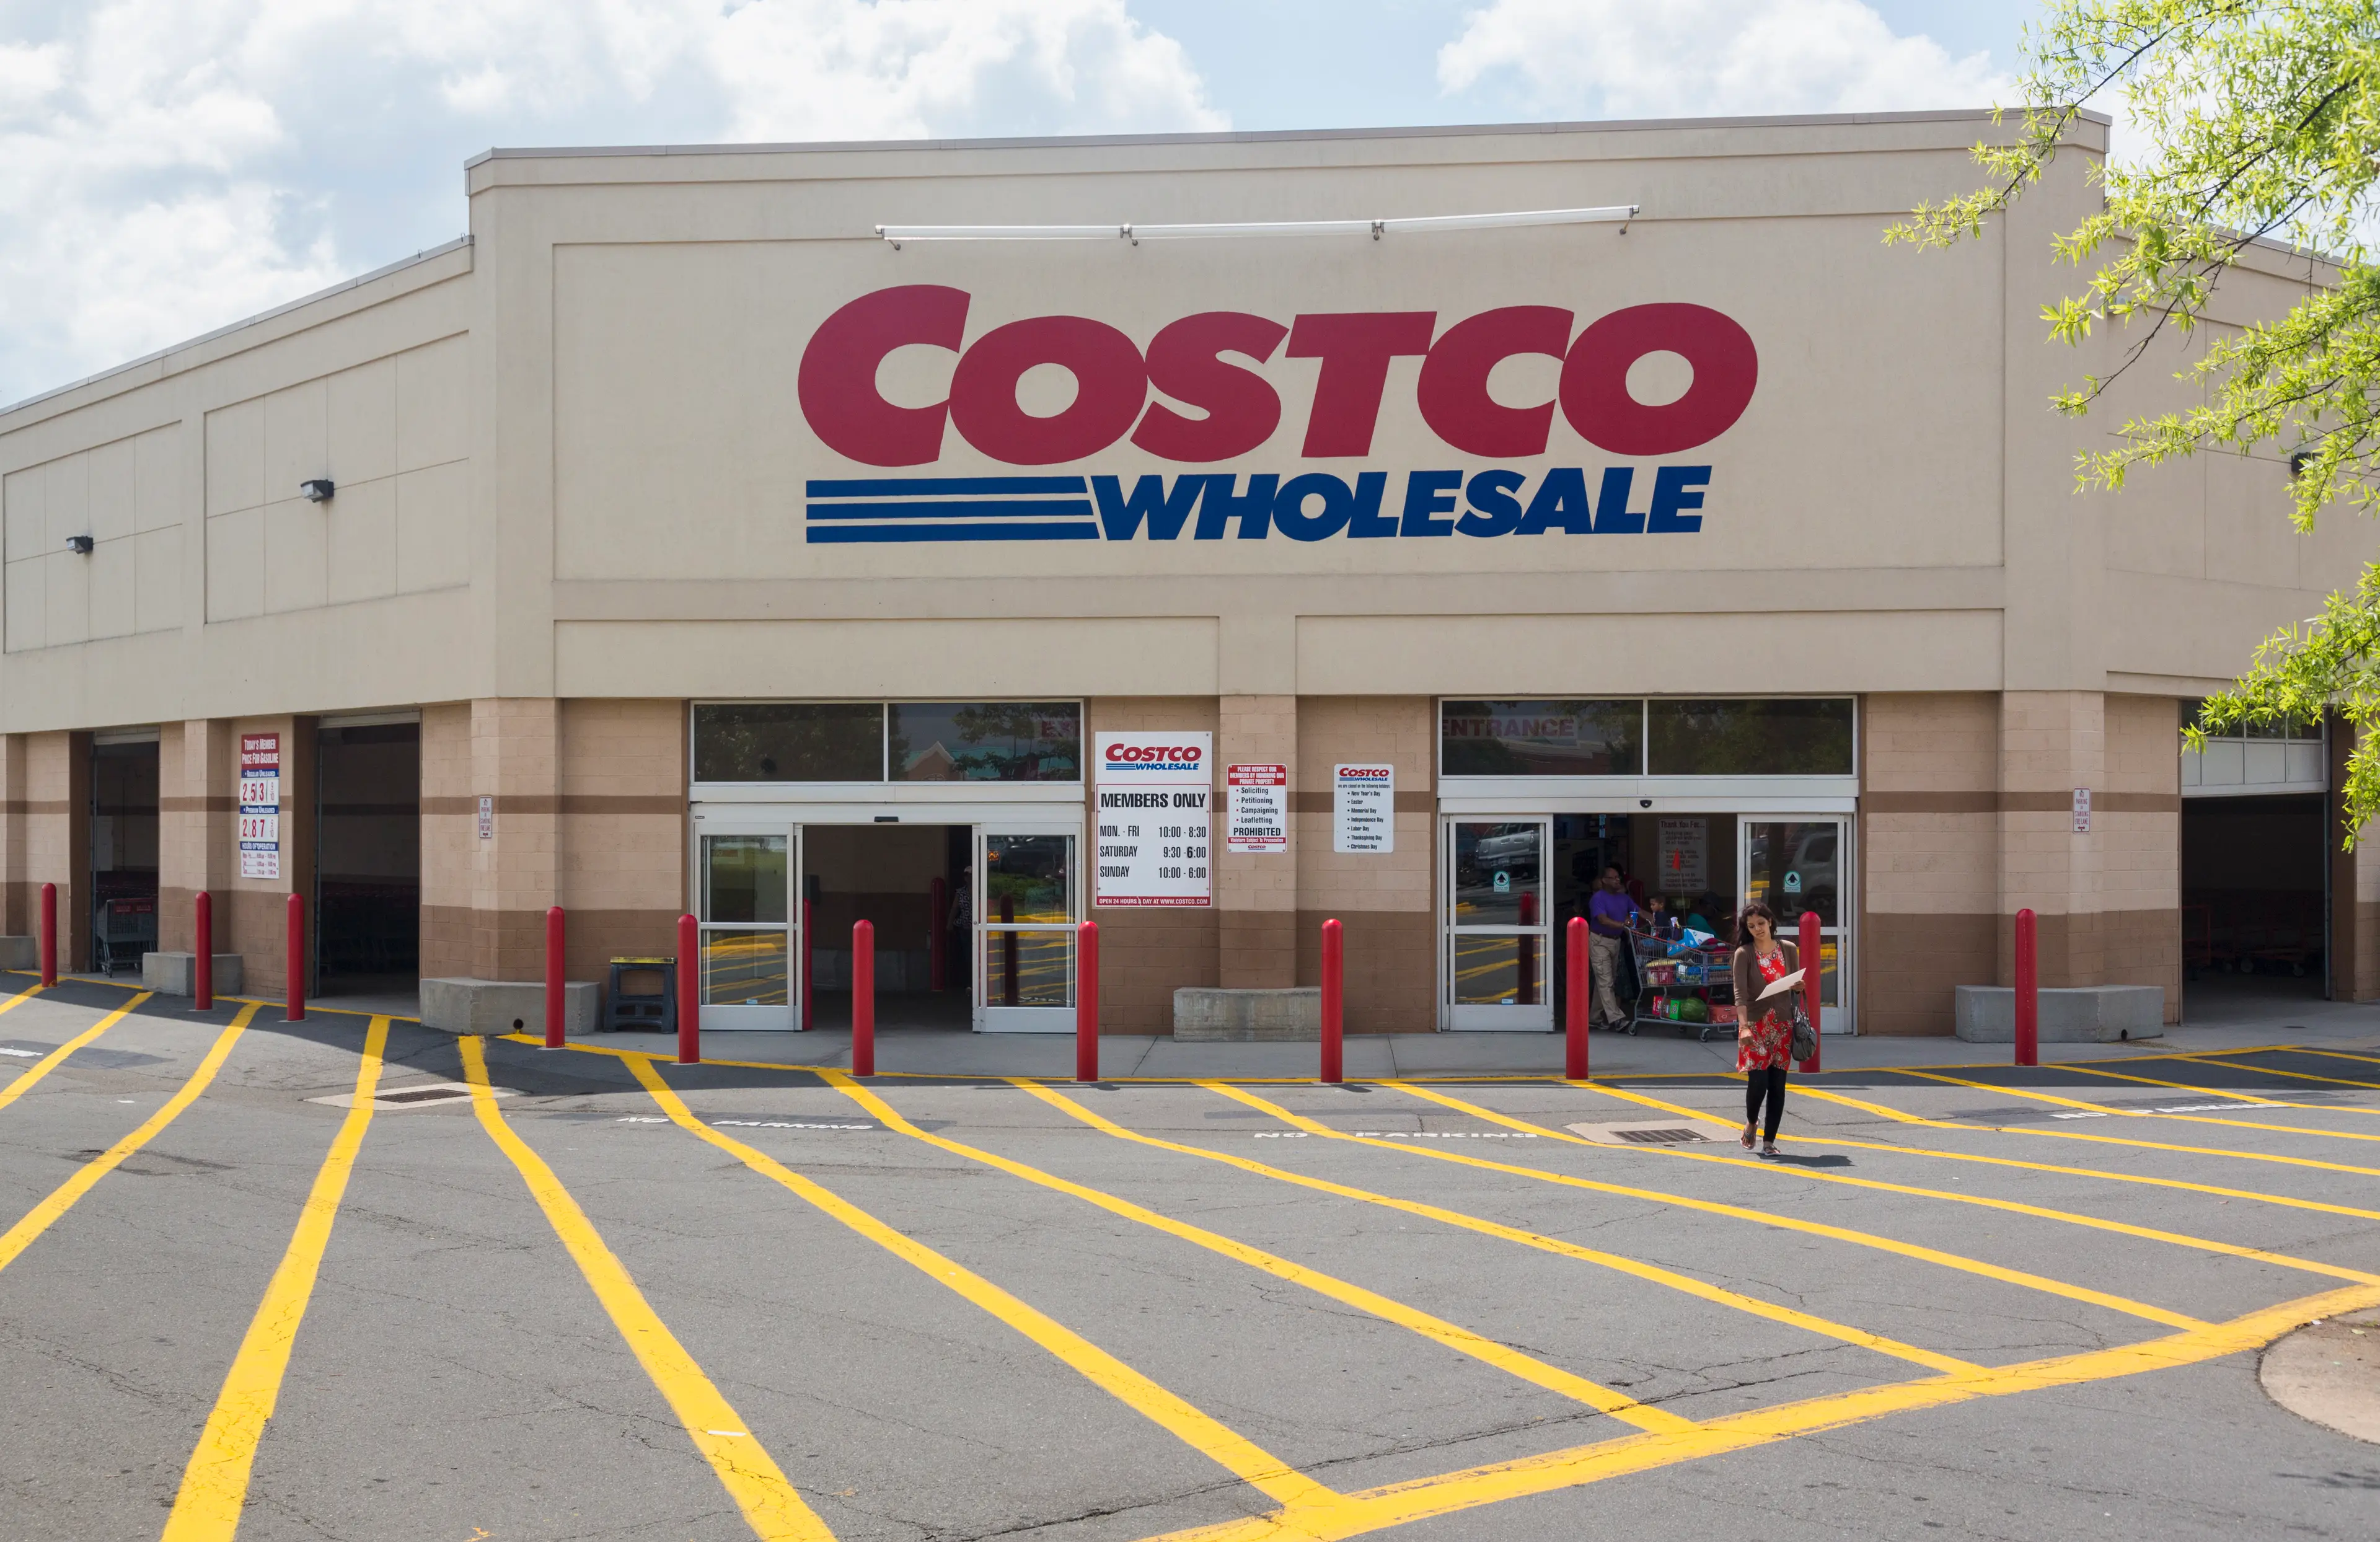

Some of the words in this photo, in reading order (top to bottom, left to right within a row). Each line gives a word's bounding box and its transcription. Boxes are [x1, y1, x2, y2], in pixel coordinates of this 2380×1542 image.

[798, 284, 1759, 467] COSTCO
[1093, 465, 1713, 541] WHOLESALE
[260, 752, 278, 764] GASOLINE
[1106, 743, 1202, 762] COSTCO
[1339, 767, 1390, 777] COSTCO
[1241, 787, 1269, 795] Soliciting
[1101, 793, 1168, 808] MEMBERS
[1173, 793, 1206, 808] ONLY
[1100, 826, 1120, 837] MON.
[1128, 826, 1140, 837] FRI
[1159, 826, 1181, 837] 10:00
[1189, 826, 1206, 837] 8:30
[1233, 827, 1281, 836] PROHIBITED
[1100, 845, 1138, 857] SATURDAY
[1163, 847, 1181, 858] 9:30
[1187, 846, 1206, 858] 6:00
[1100, 866, 1130, 877] SUNDAY
[1159, 867, 1181, 878] 10:00
[1189, 867, 1206, 878] 6:00
[711, 1121, 873, 1130] PARKING
